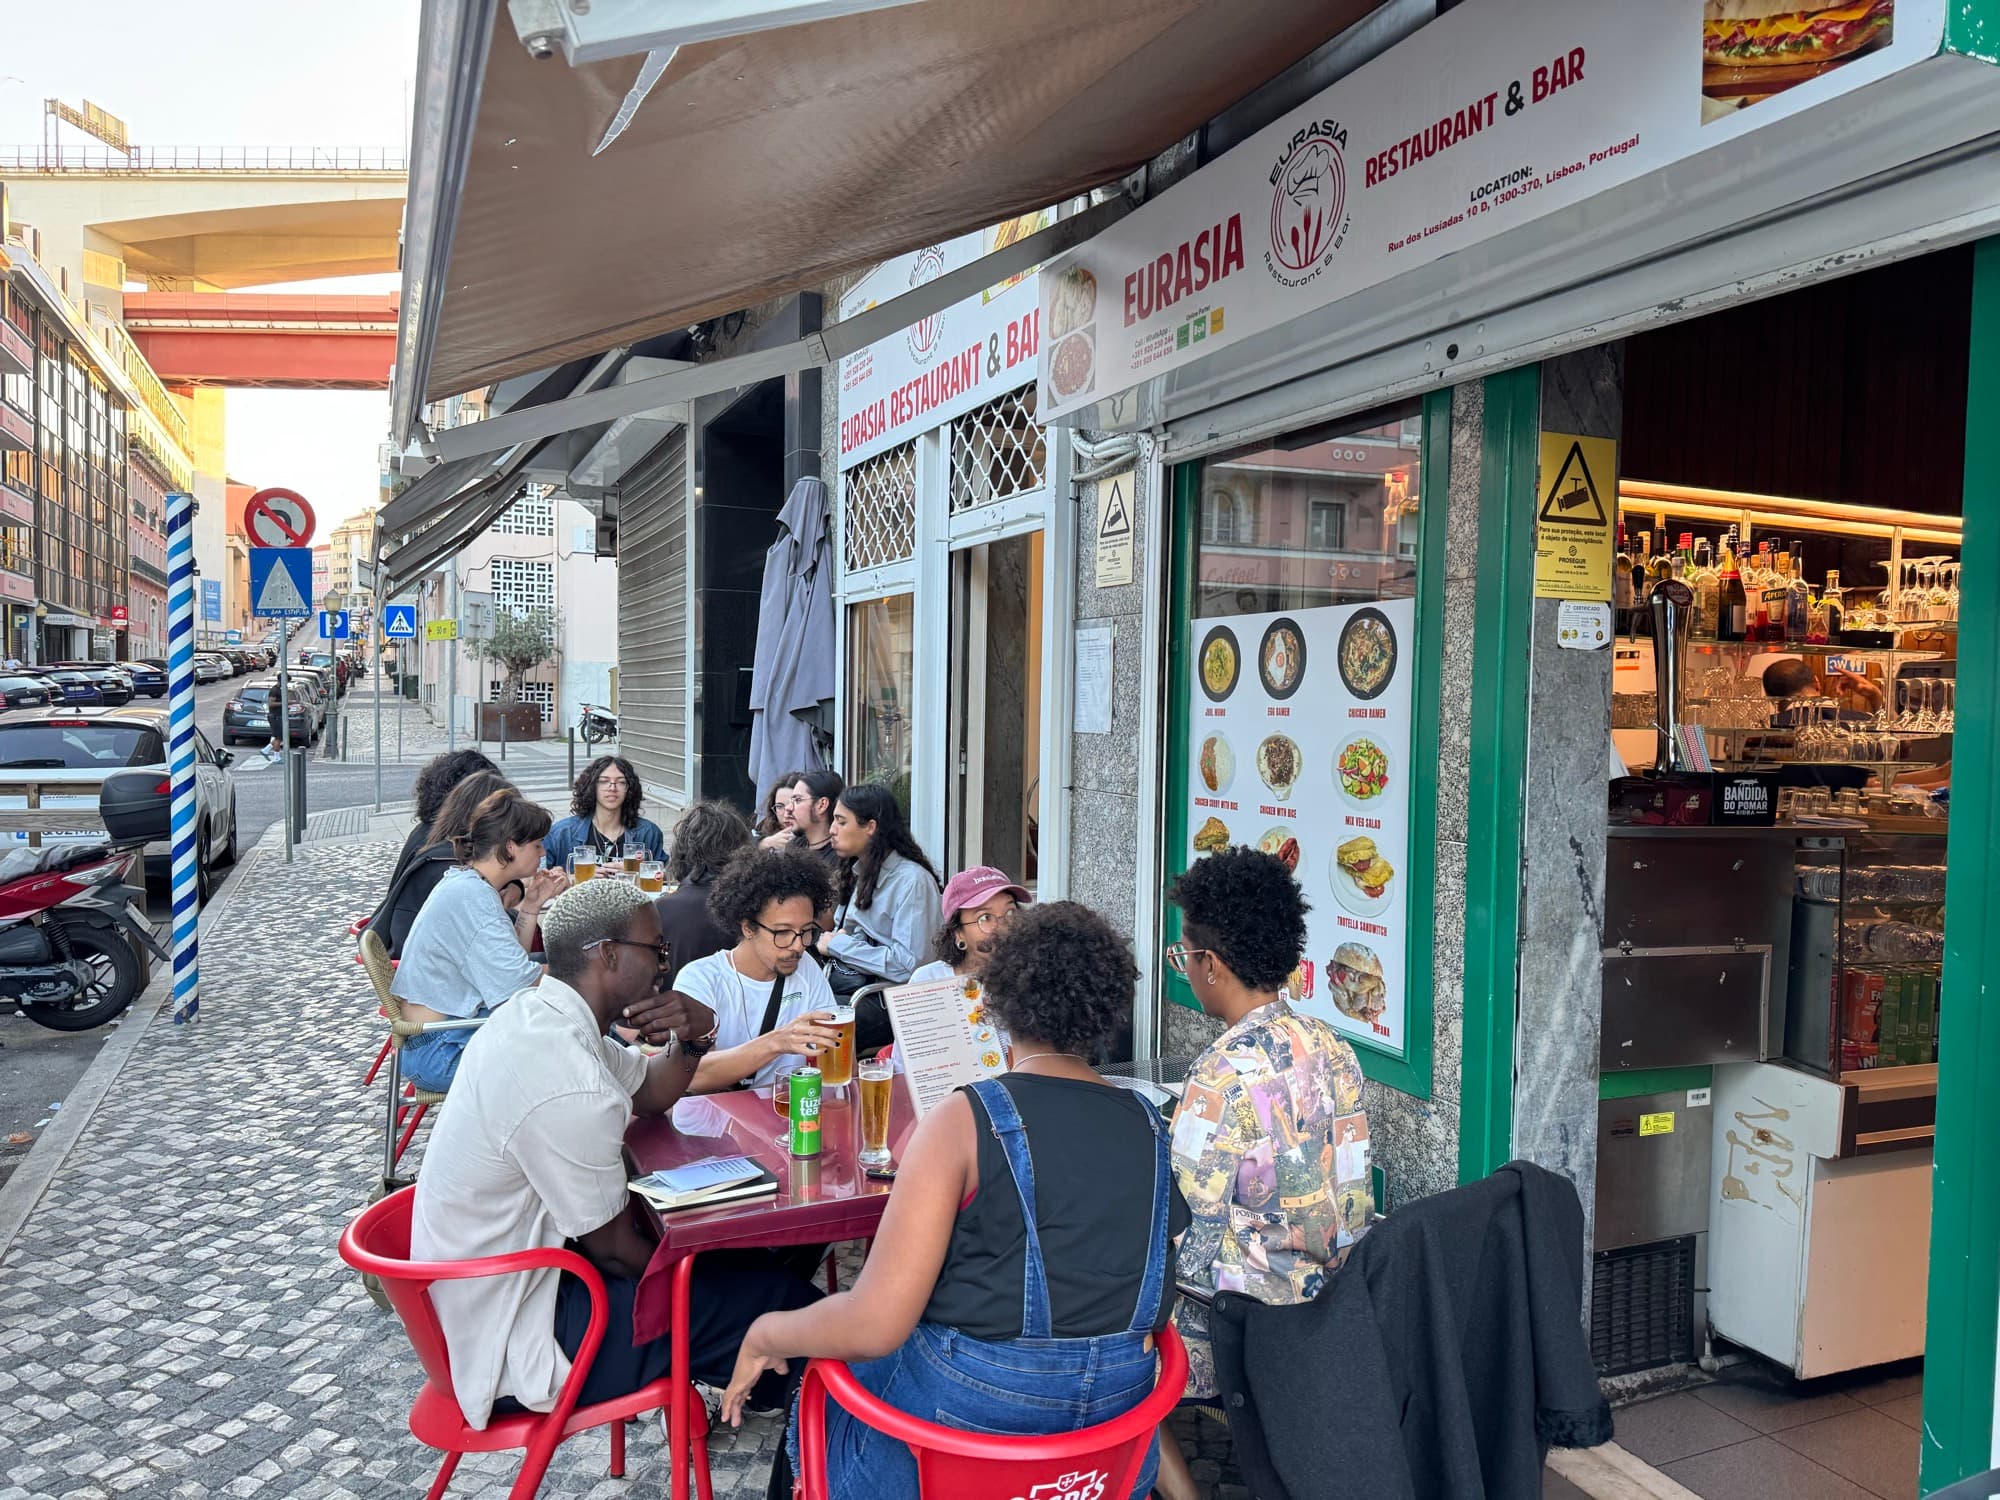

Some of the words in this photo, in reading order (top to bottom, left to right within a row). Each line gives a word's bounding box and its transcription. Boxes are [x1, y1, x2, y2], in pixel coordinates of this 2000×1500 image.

[1365, 91, 1498, 189] RESTAURANT
[1504, 80, 1525, 117] &
[1532, 46, 1585, 104] BAR
[1268, 119, 1348, 186] EURASIA
[1388, 240, 1404, 253] Rua
[1406, 231, 1422, 244] dos
[1466, 205, 1478, 219] 10
[1480, 201, 1491, 213] D,
[1493, 178, 1543, 206] 1300-370,
[1546, 162, 1585, 185] Lisboa,
[1589, 134, 1640, 166] Portugal
[1470, 165, 1533, 202] LOCATION:
[1264, 252, 1323, 288] Restaurant
[1334, 213, 1351, 250] Bar
[1124, 212, 1245, 328] EURASIA
[841, 398, 886, 454] EURASIA
[890, 341, 982, 429] RESTAURANT
[987, 332, 1001, 378] &
[14, 616, 28, 628] P
[325, 613, 343, 636] P
[1348, 708, 1368, 718] CHICKEN
[1724, 786, 1768, 801] BANDIDA
[1260, 805, 1276, 816] CHICKEN
[1277, 807, 1287, 817] WITH
[1288, 808, 1297, 819] RICE
[1723, 801, 1736, 810] DO
[1737, 801, 1768, 810] POMAR
[1345, 815, 1354, 826] MIX
[1356, 816, 1365, 827] VEG
[1365, 818, 1381, 829] SALAD
[800, 1106, 819, 1117] tea
